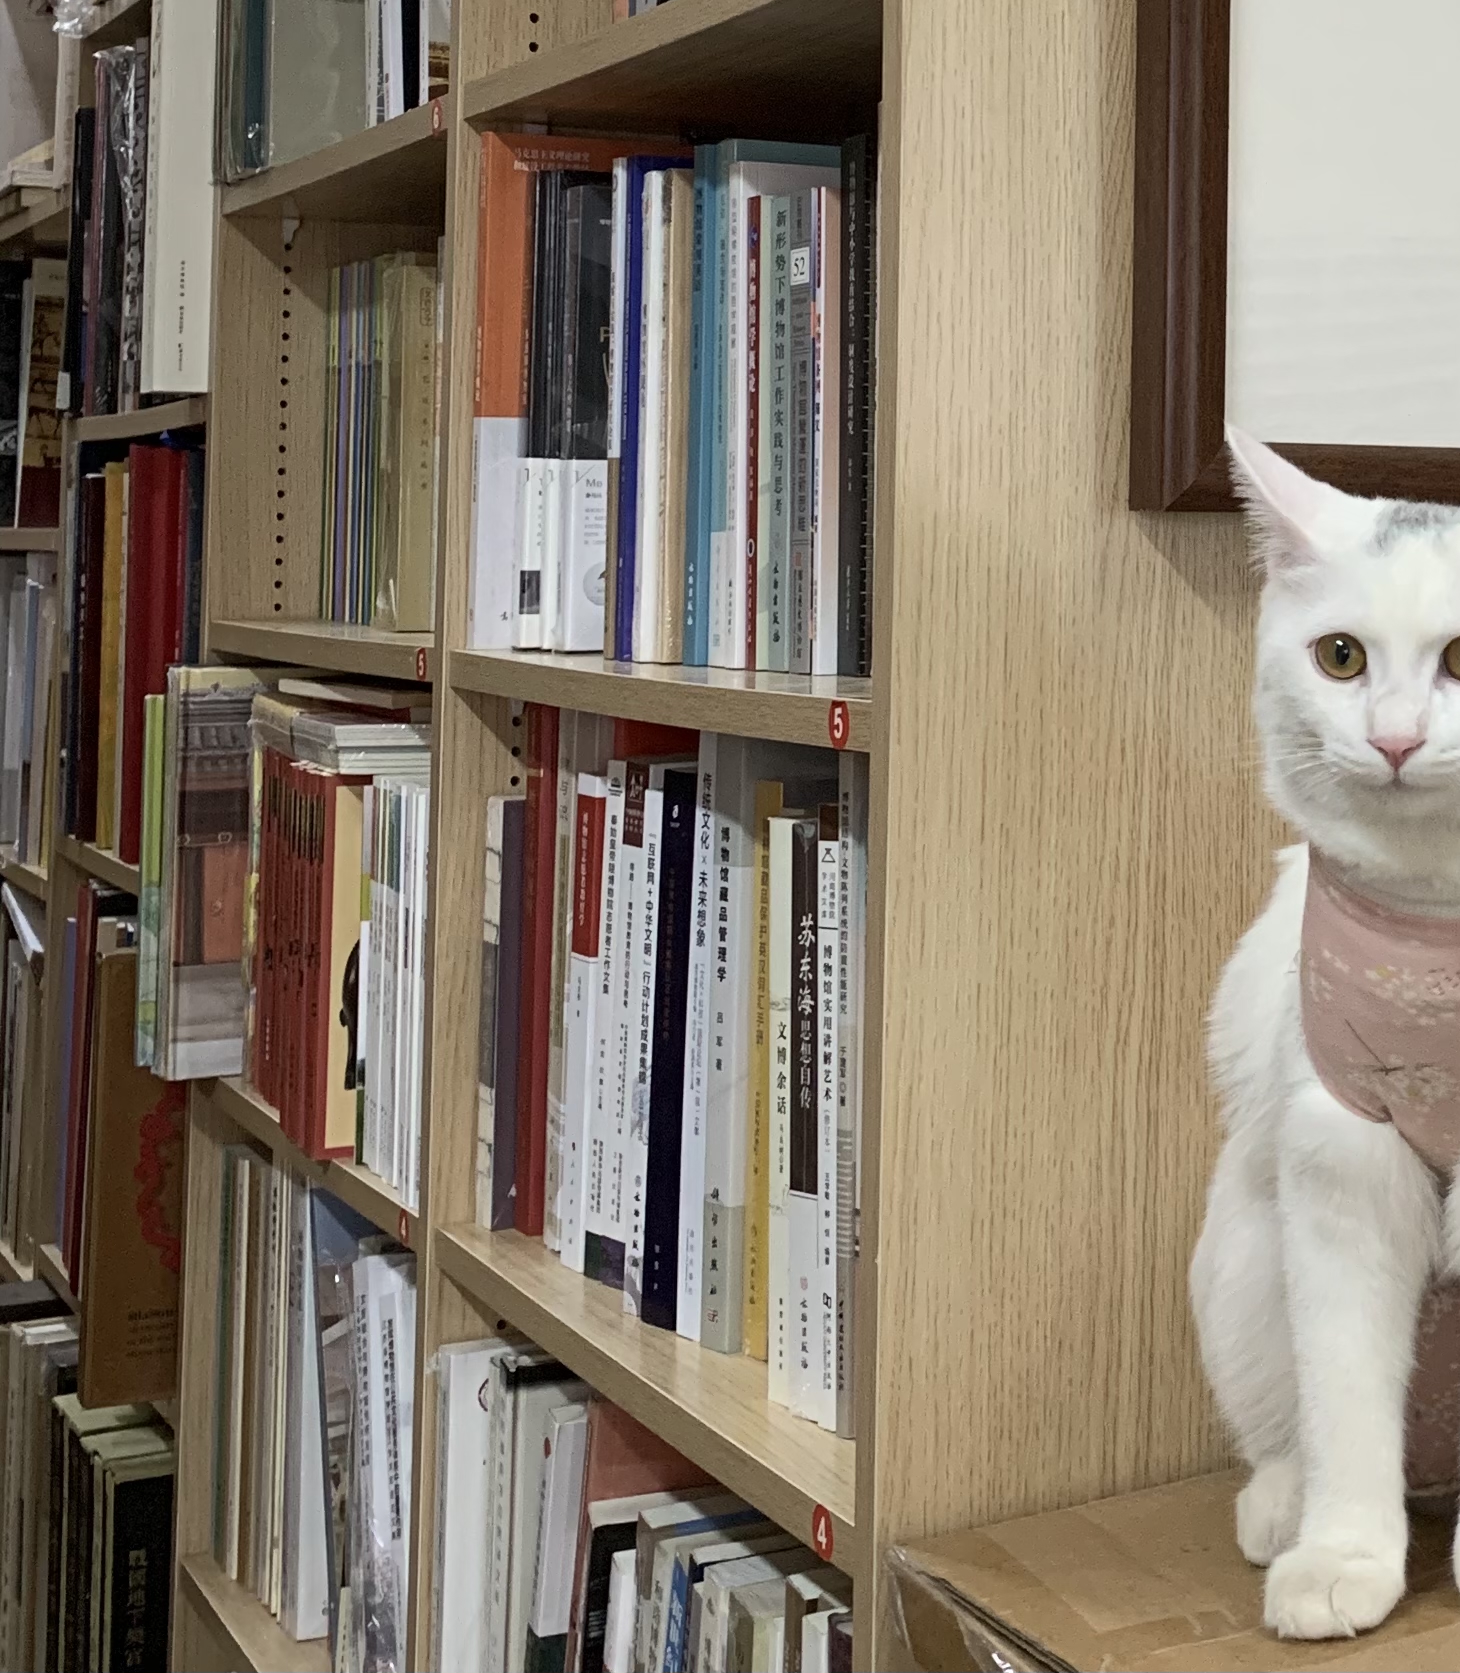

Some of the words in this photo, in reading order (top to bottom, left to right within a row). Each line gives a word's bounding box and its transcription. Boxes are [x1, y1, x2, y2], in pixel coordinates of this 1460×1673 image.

[793, 257, 805, 277] 52
[773, 210, 787, 516] 新形势下博物馆工作实践与思考
[831, 707, 843, 739] 5
[717, 827, 730, 982] 博物馆藏品管理学
[776, 1021, 787, 1115] 文博余话
[817, 1521, 826, 1549] 4
